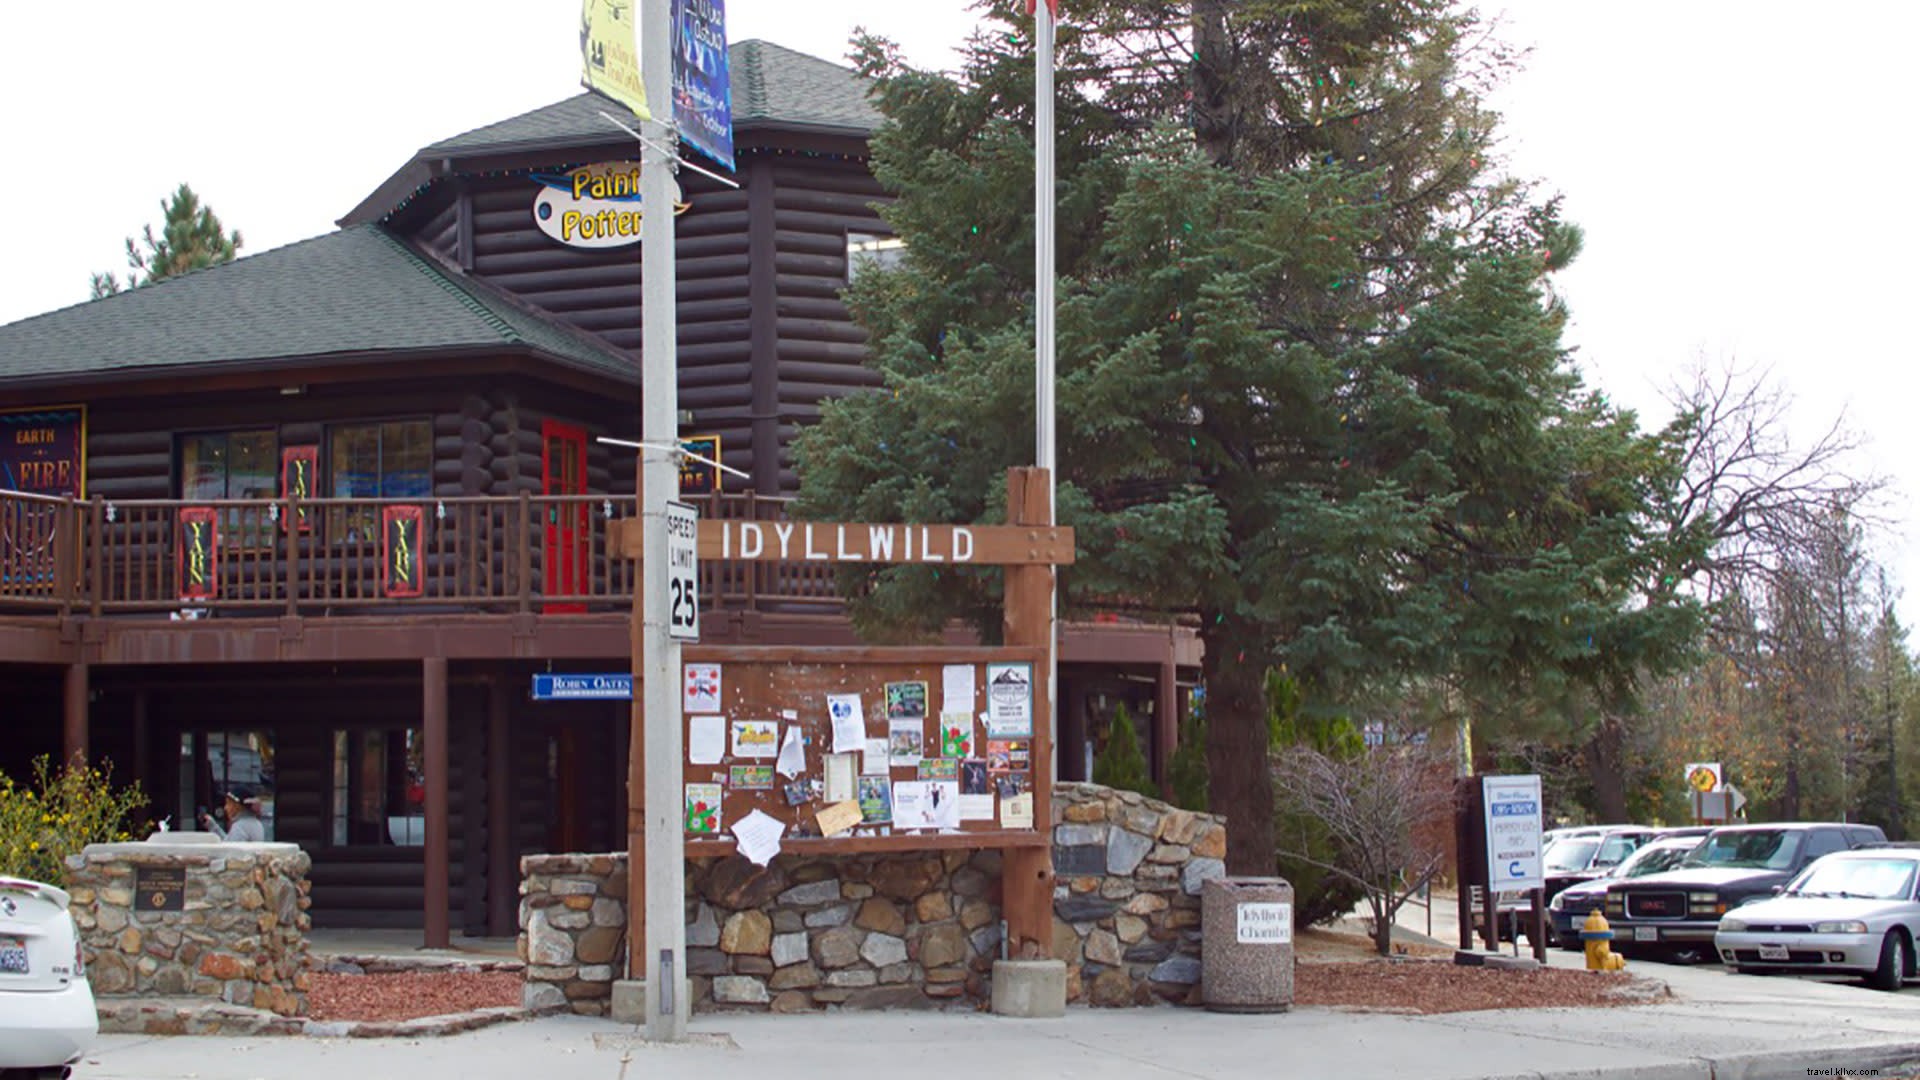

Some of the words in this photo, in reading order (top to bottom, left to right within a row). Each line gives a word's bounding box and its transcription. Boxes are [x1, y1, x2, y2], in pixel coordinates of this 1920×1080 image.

[562, 209, 642, 240] Potter
[16, 429, 55, 444] EARTH
[19, 460, 71, 489] FIRE
[667, 514, 695, 539] SPEED
[721, 522, 975, 562] IDYLLWILD
[671, 546, 694, 568] LIMIT
[671, 577, 695, 627] 25
